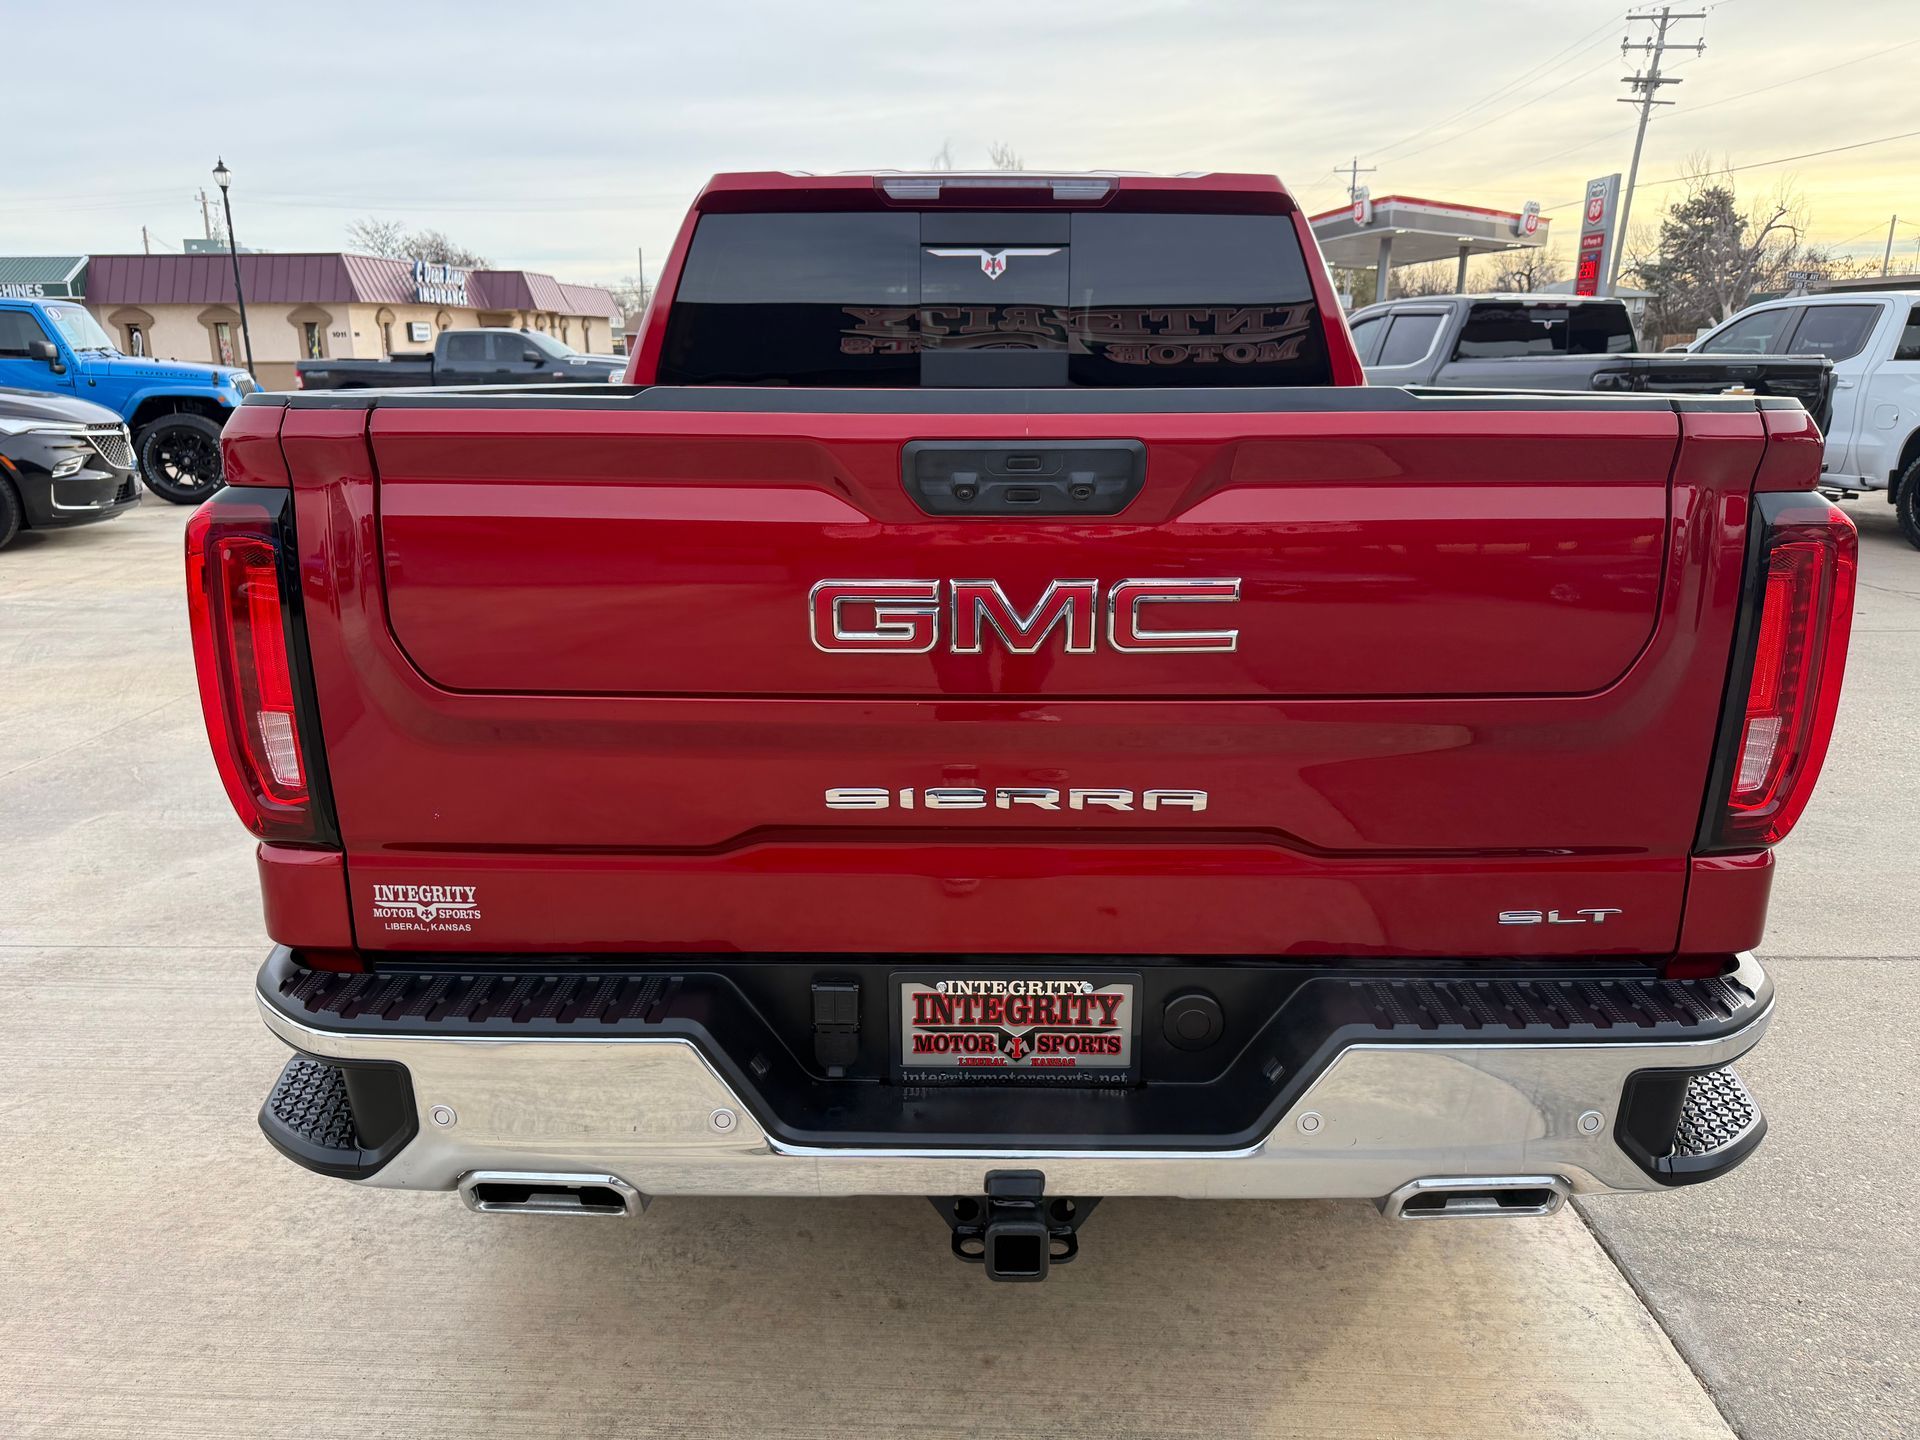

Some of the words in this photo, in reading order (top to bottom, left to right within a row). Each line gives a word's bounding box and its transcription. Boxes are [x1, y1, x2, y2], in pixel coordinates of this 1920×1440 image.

[1589, 199, 1602, 218] 66
[1527, 215, 1537, 230] 66
[0, 284, 44, 298] HINES
[418, 286, 468, 306] INSURANCE
[808, 577, 1242, 654] GMC
[825, 787, 1208, 812] SIERRA
[373, 884, 477, 902] INTEGRITY
[373, 908, 416, 918] MOTOR
[438, 909, 481, 919] SPORTS
[1498, 908, 1622, 924] SLT
[385, 922, 430, 932] LIBERAL,
[431, 923, 472, 932] KANSAS
[945, 980, 1087, 996] INTEGRITY
[912, 993, 1125, 1027] INTEGRITY
[912, 1033, 999, 1055] MOTOR
[1036, 1034, 1123, 1056] SPORTS
[1030, 1056, 1076, 1066] KANSAS
